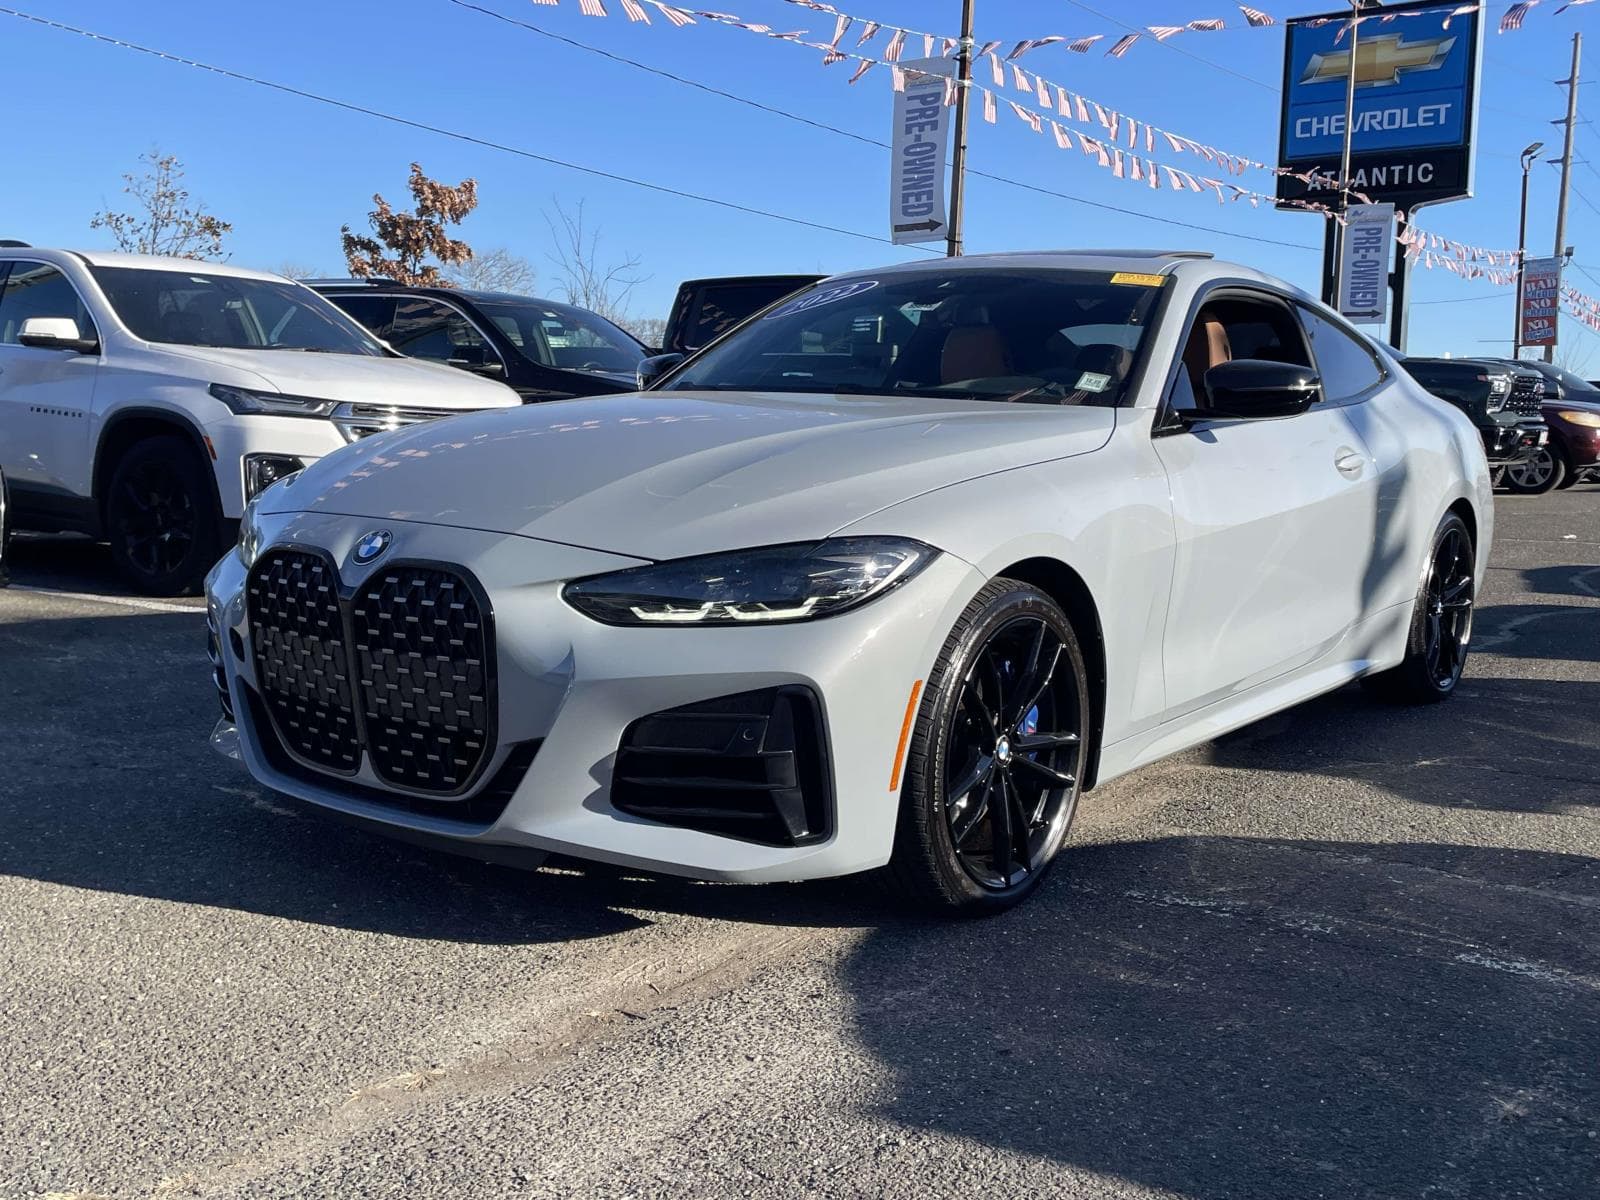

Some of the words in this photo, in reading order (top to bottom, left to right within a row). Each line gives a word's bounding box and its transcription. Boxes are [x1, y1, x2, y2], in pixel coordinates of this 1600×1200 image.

[1295, 103, 1452, 138] CHEVROLET
[901, 92, 941, 218] PRE-OWNED
[1350, 227, 1383, 308] PRE-OWNED
[1525, 278, 1557, 292] BAD
[1530, 298, 1551, 310] NO
[1528, 319, 1549, 331] NO
